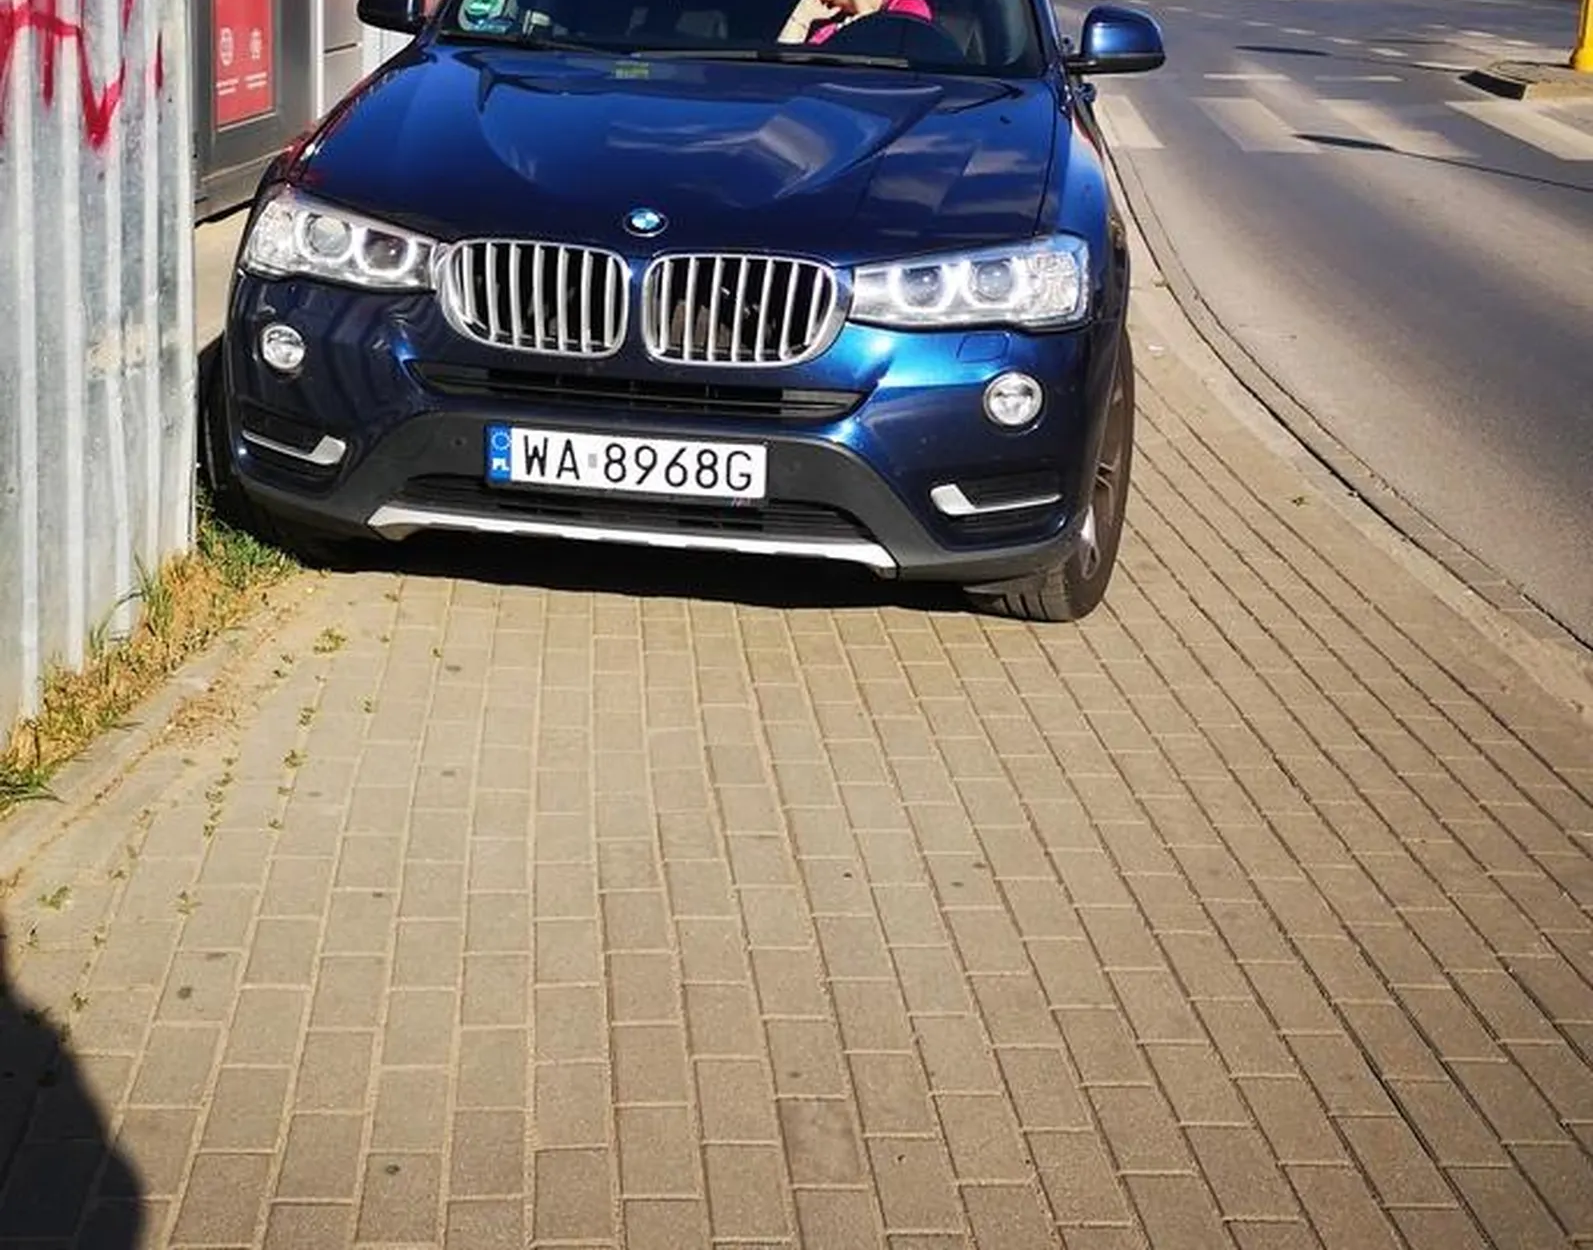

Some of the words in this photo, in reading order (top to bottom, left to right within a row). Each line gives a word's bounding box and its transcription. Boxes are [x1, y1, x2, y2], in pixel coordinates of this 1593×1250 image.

[491, 458, 510, 471] PL
[523, 434, 581, 481] WA
[603, 442, 753, 492] 8968G
